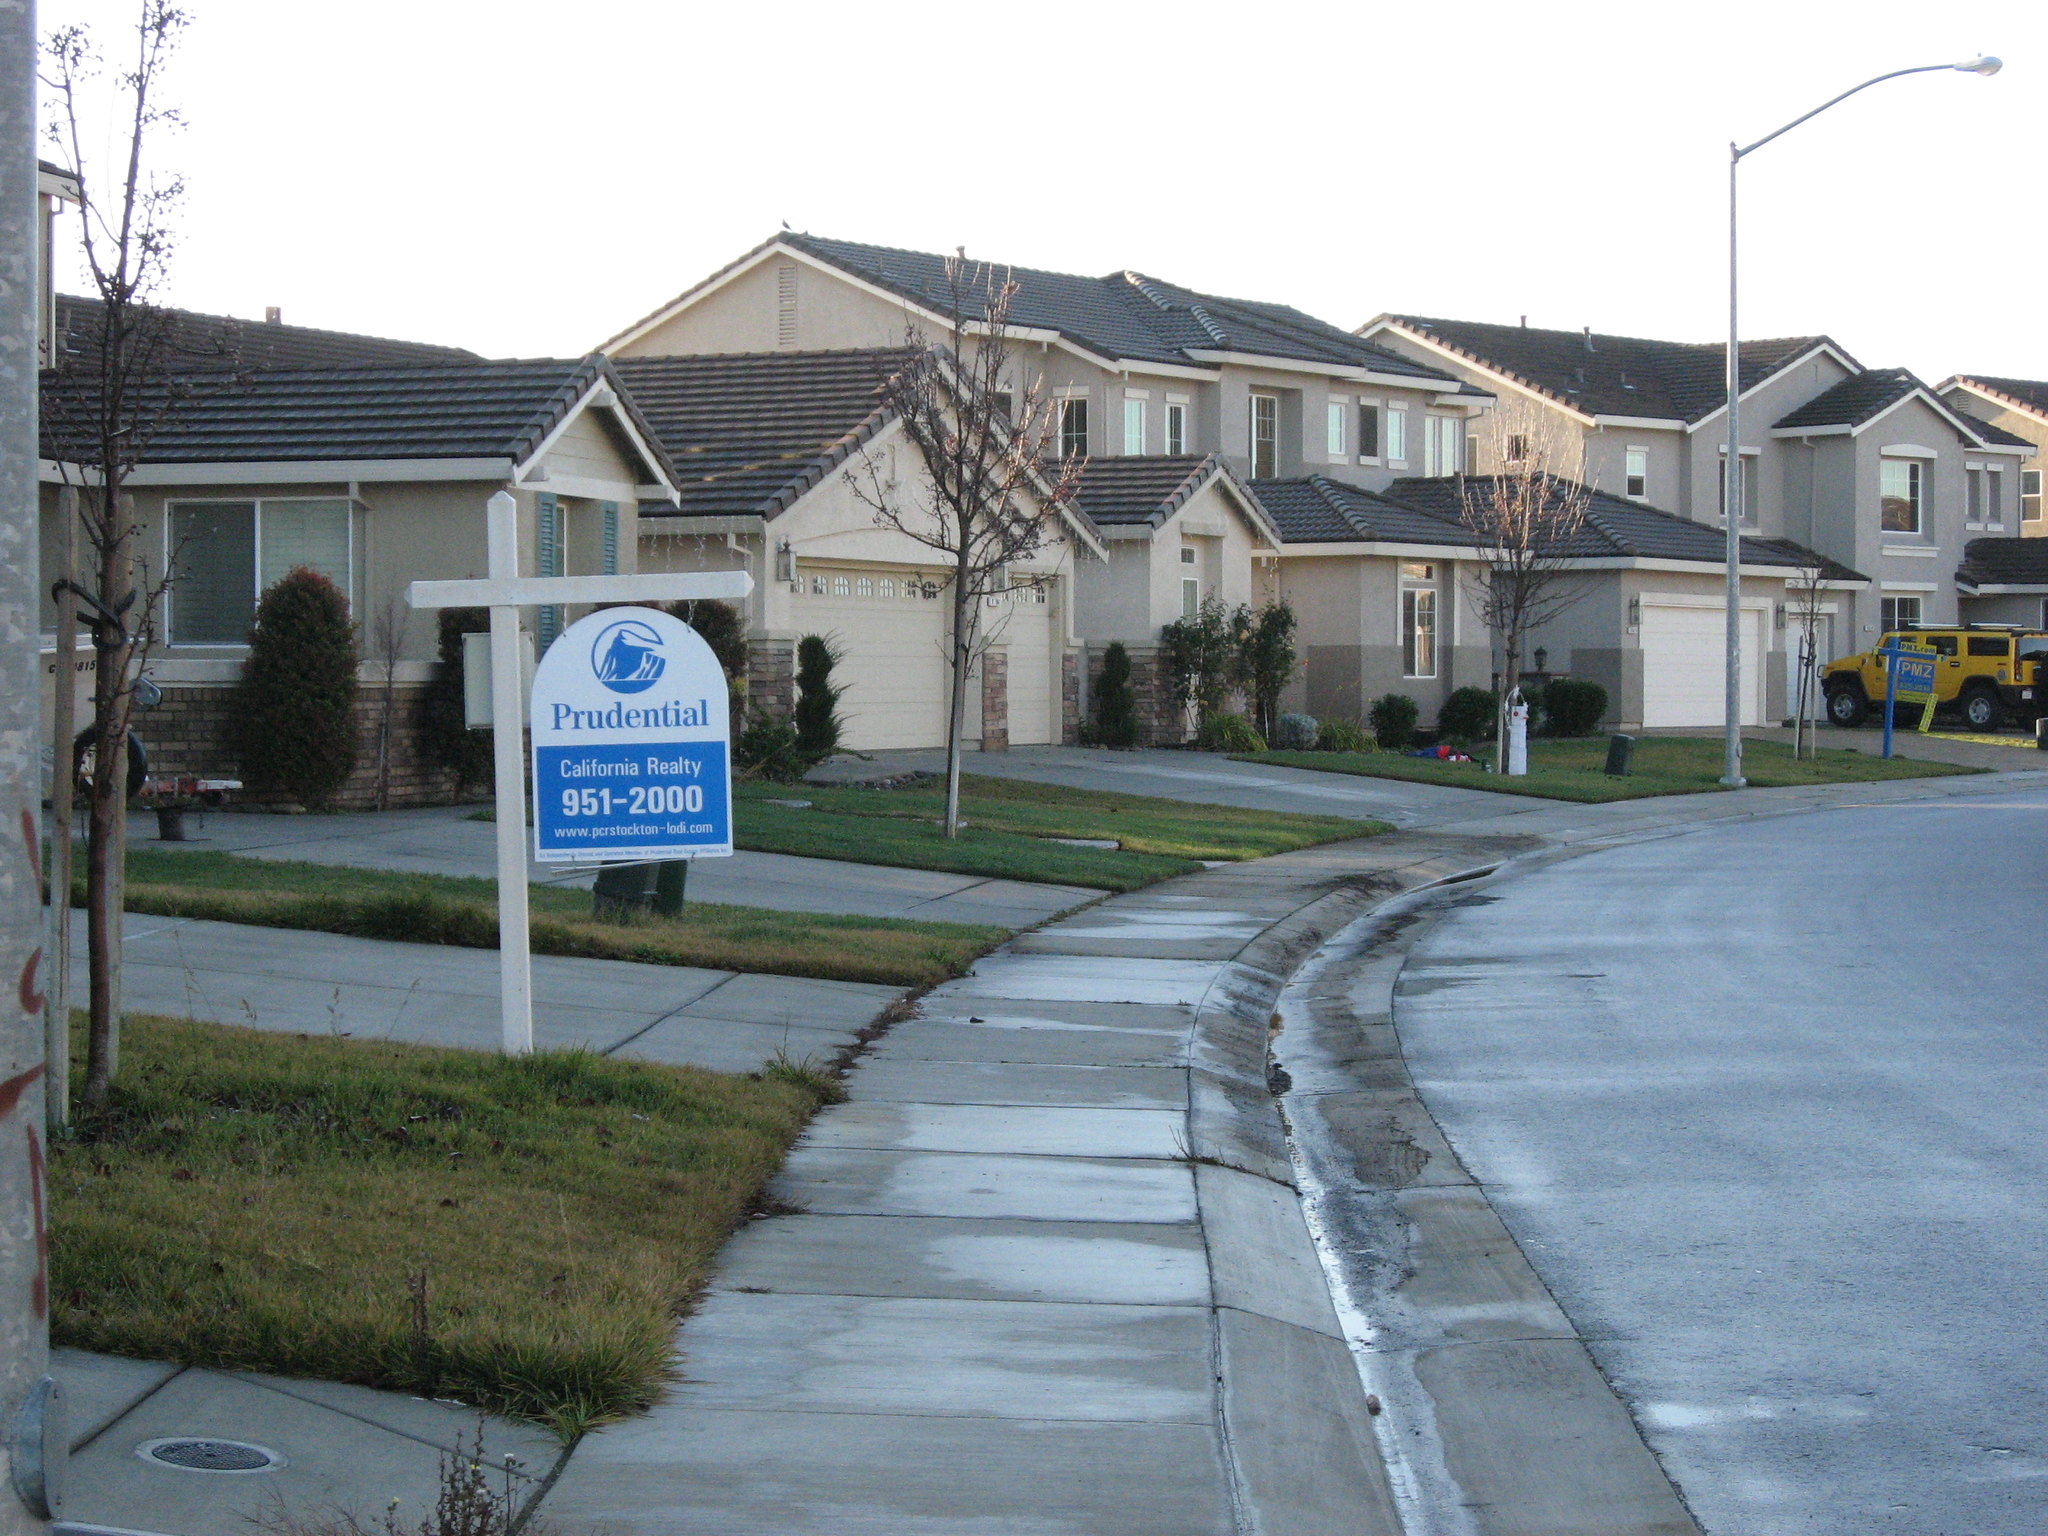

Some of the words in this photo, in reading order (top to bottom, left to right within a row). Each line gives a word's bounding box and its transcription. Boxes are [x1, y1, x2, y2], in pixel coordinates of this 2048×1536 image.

[1902, 662, 1933, 678] PMZ
[551, 699, 709, 730] Prudential
[560, 758, 639, 778] California
[647, 757, 701, 778] Realty
[562, 785, 703, 817] 951-2000
[554, 822, 713, 839] www.pcrstockton-lodi.com
